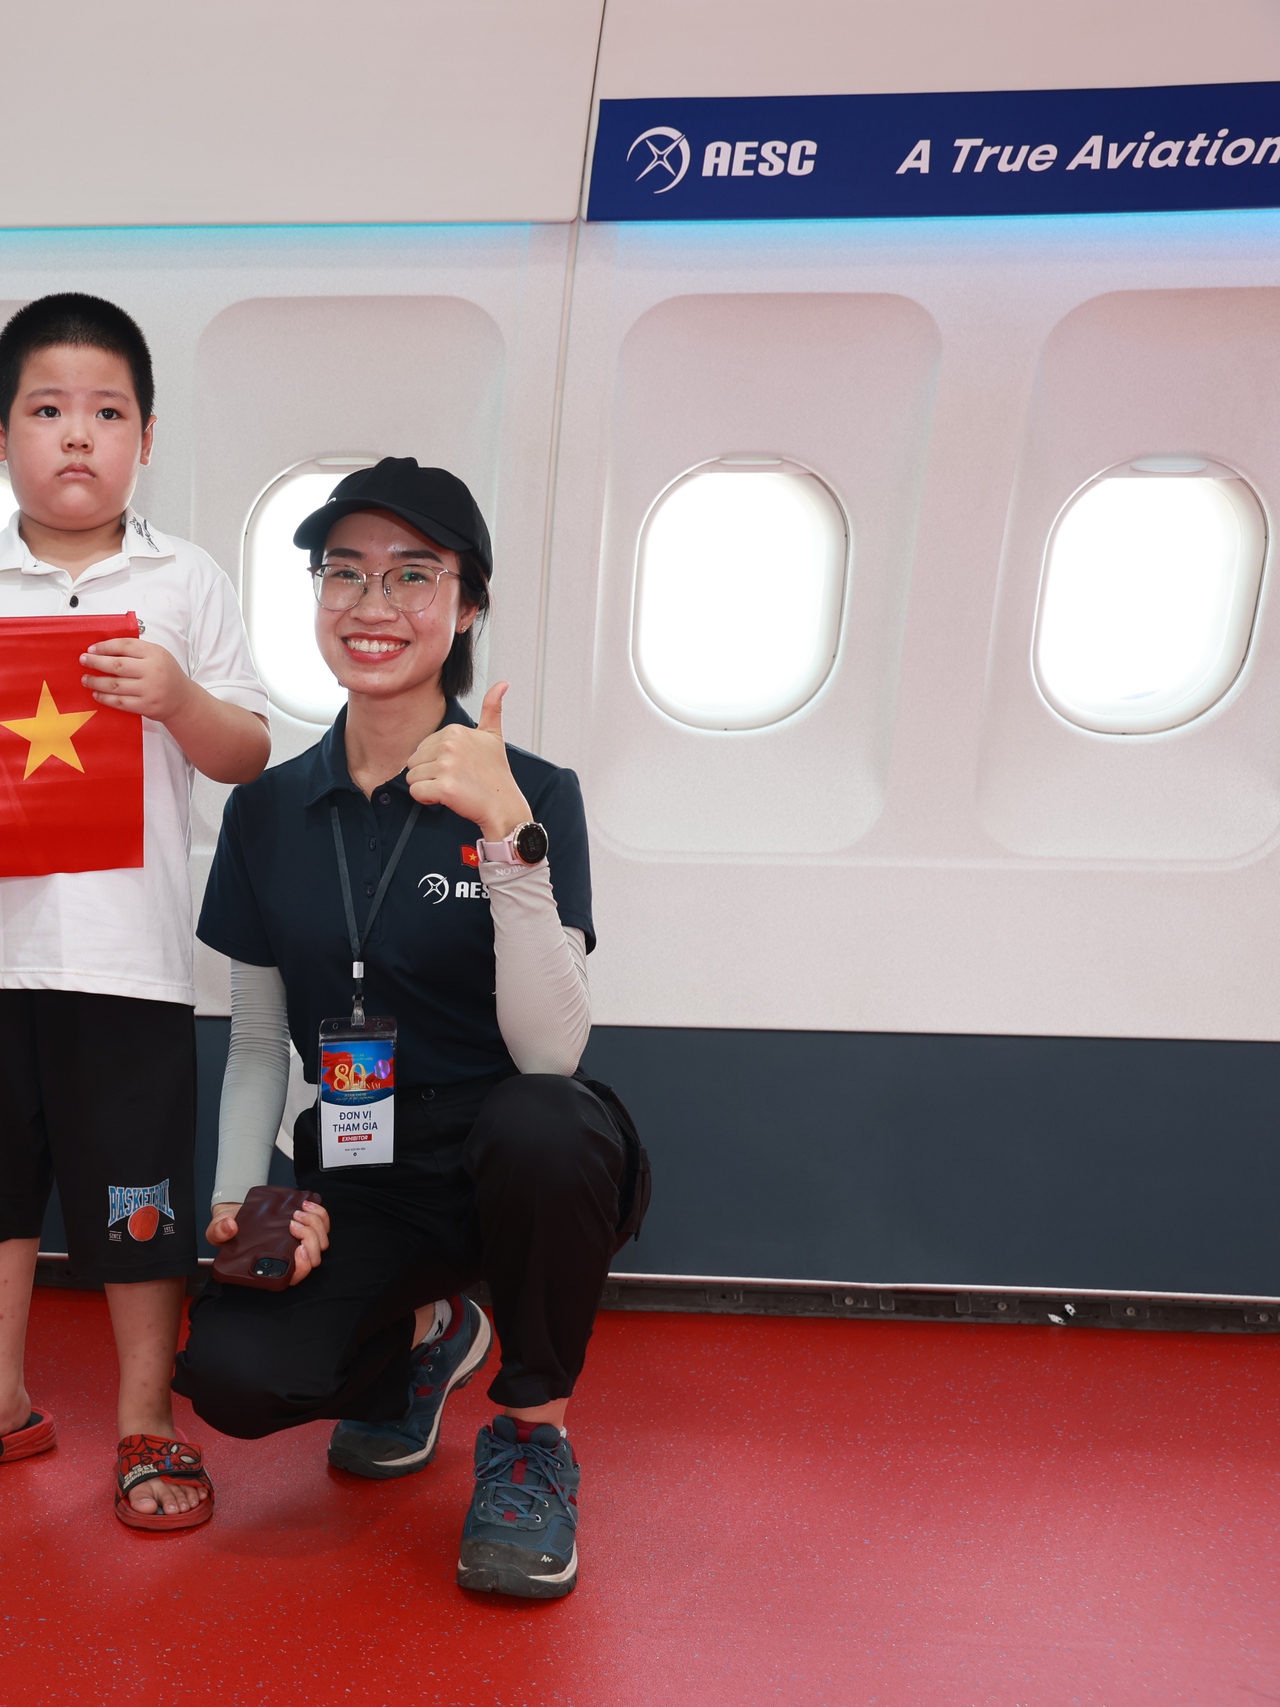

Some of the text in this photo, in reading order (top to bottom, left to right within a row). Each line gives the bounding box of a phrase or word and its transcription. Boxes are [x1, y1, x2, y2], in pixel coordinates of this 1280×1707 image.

[701, 139, 818, 177] AESC
[896, 128, 1280, 174] A True Aviation
[455, 881, 490, 899] AES
[333, 1063, 367, 1091] 80
[332, 1122, 378, 1132] THAM GIA
[339, 1110, 372, 1121] ĐƠN VỊ
